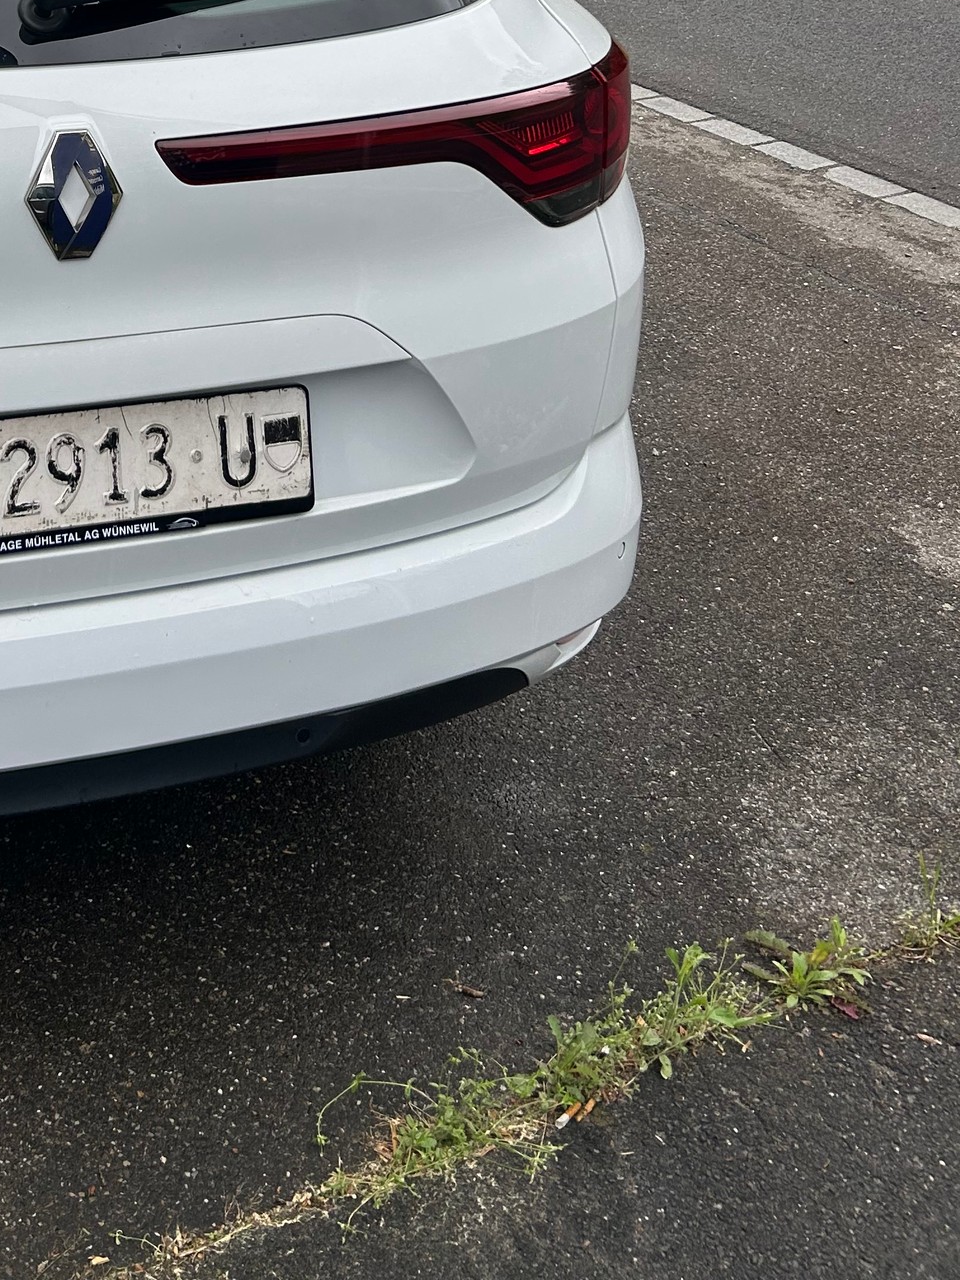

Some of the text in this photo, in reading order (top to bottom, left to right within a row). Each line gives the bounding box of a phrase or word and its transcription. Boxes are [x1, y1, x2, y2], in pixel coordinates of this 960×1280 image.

[216, 411, 257, 489] U
[25, 531, 82, 548] MÜHLETAL
[84, 529, 100, 540] AG
[102, 521, 159, 537] WÜNNEWIL
